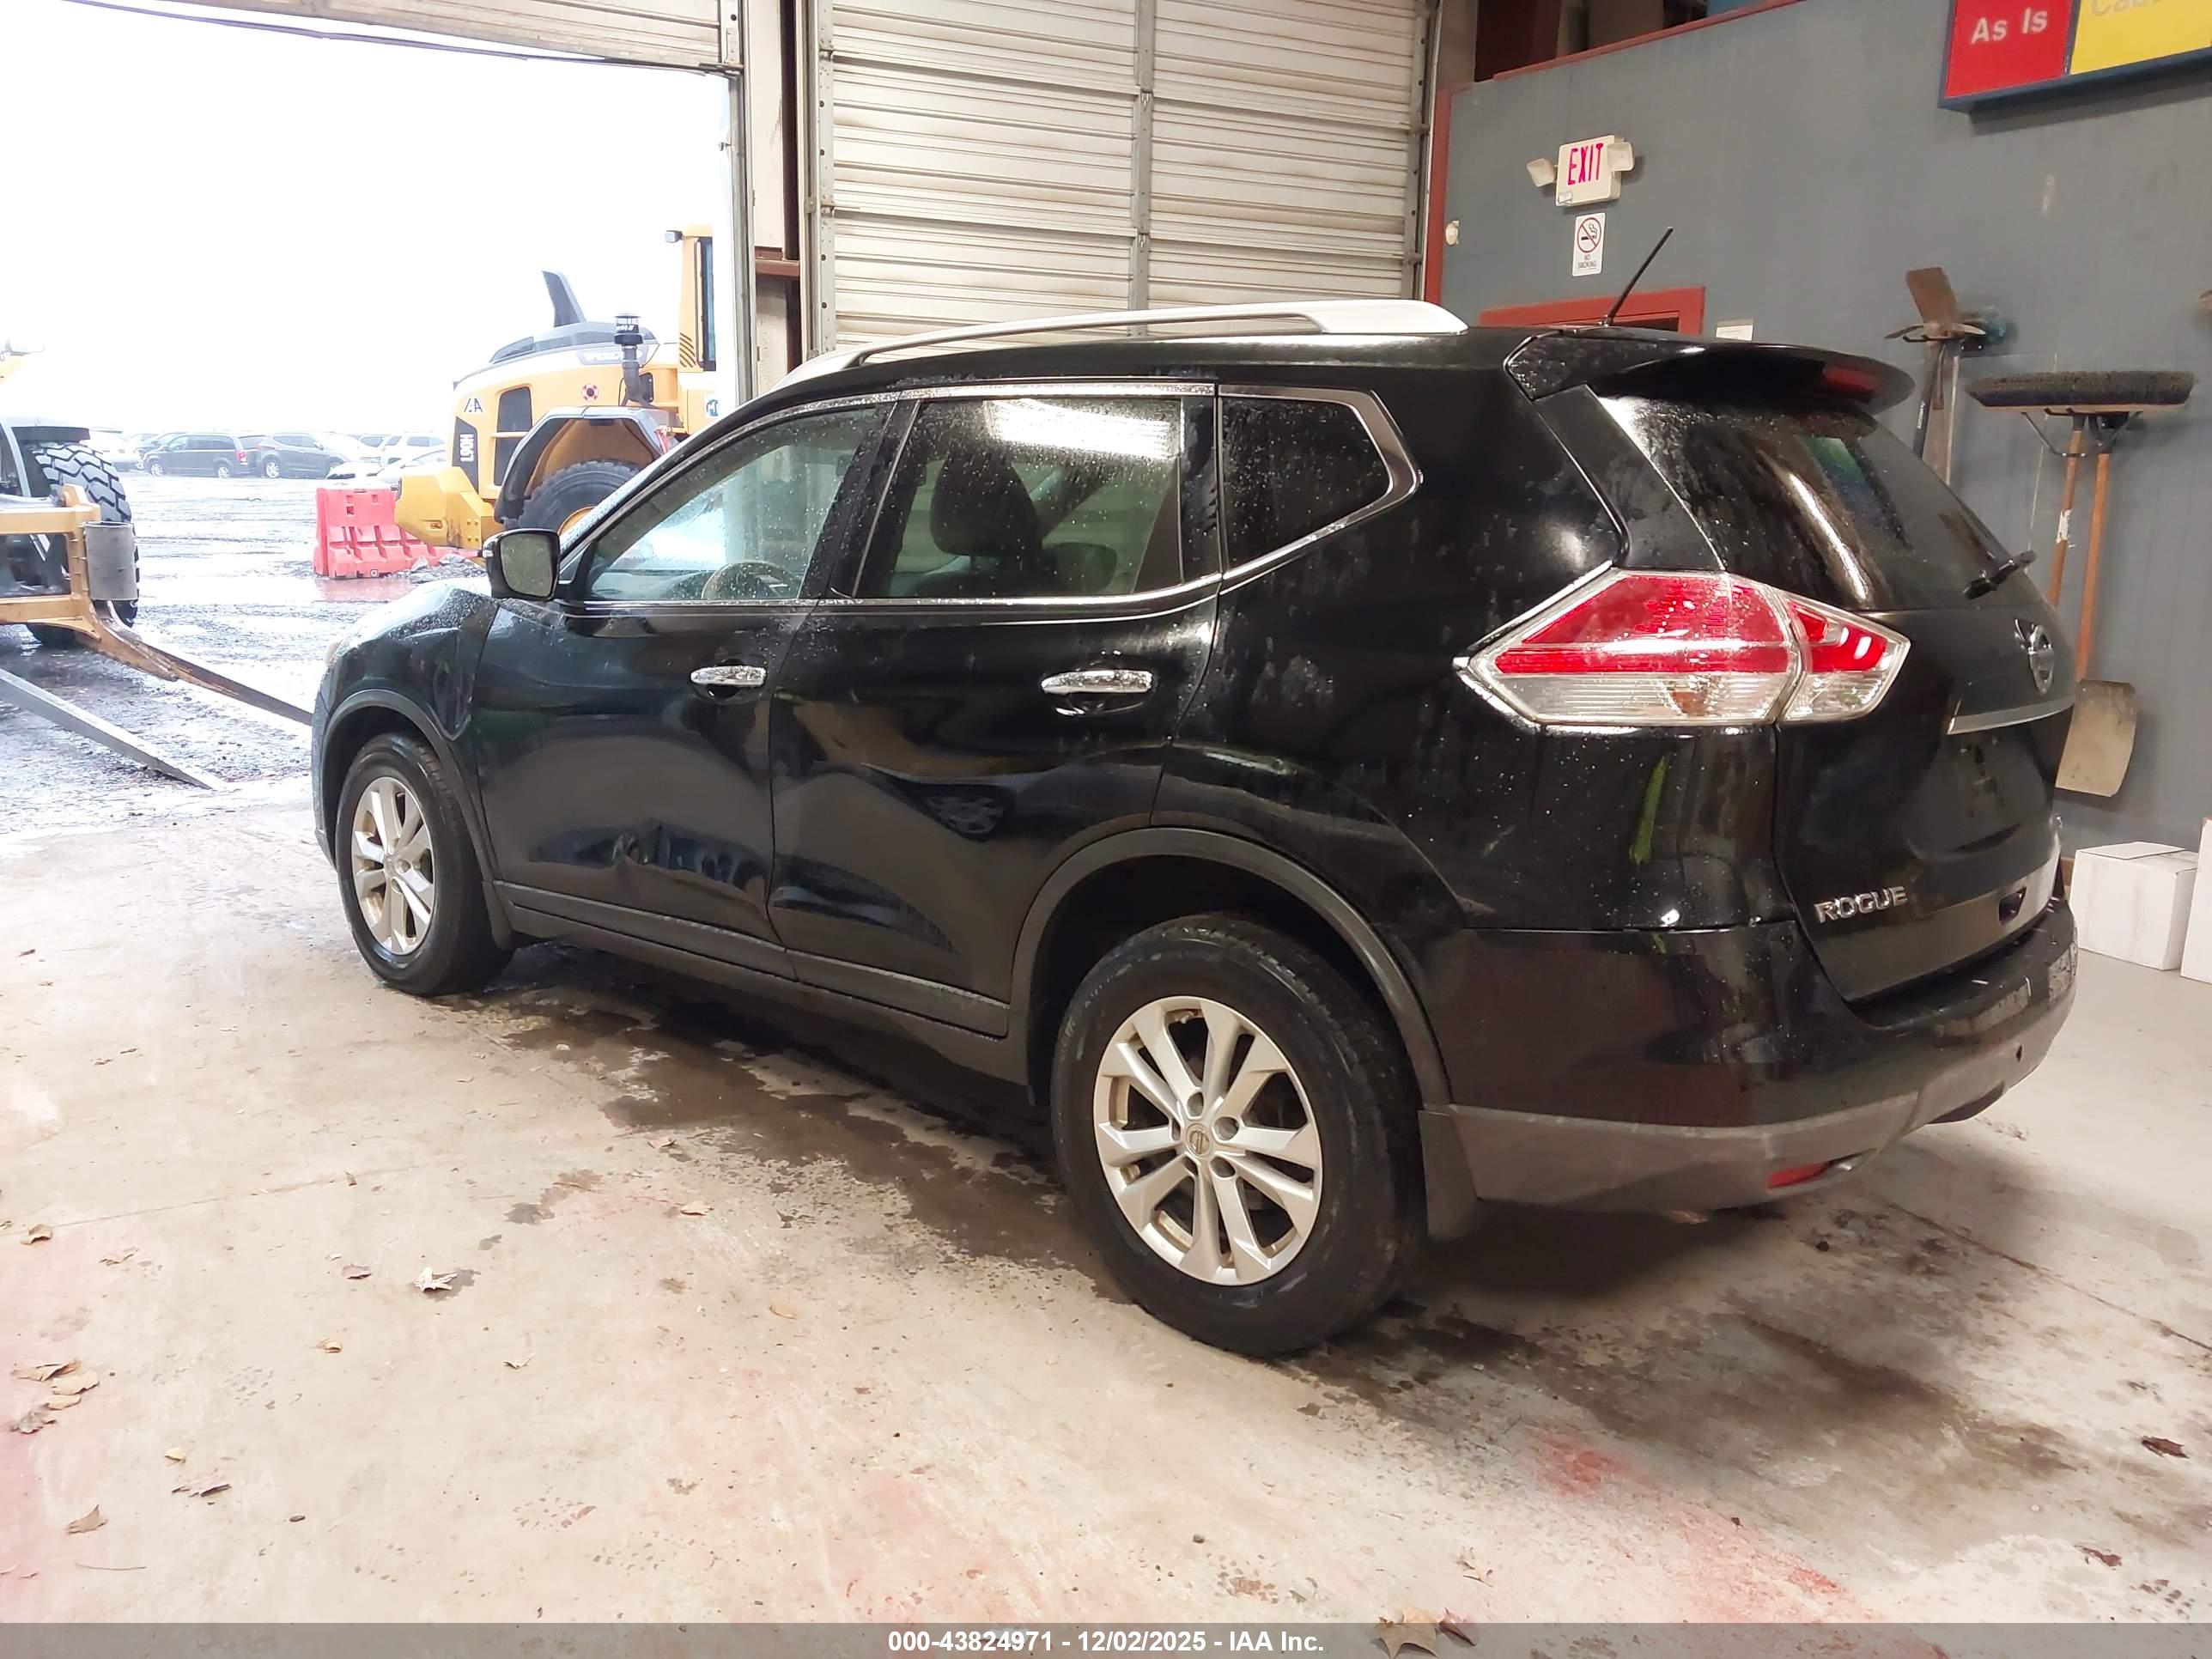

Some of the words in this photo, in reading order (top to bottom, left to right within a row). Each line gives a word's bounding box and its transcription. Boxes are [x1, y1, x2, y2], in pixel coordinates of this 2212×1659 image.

[1971, 17, 2008, 45] As
[2021, 8, 2048, 34] Is
[1568, 143, 1603, 185] EXIT
[459, 434, 475, 462] L90H
[1814, 885, 1908, 924] ROGUE
